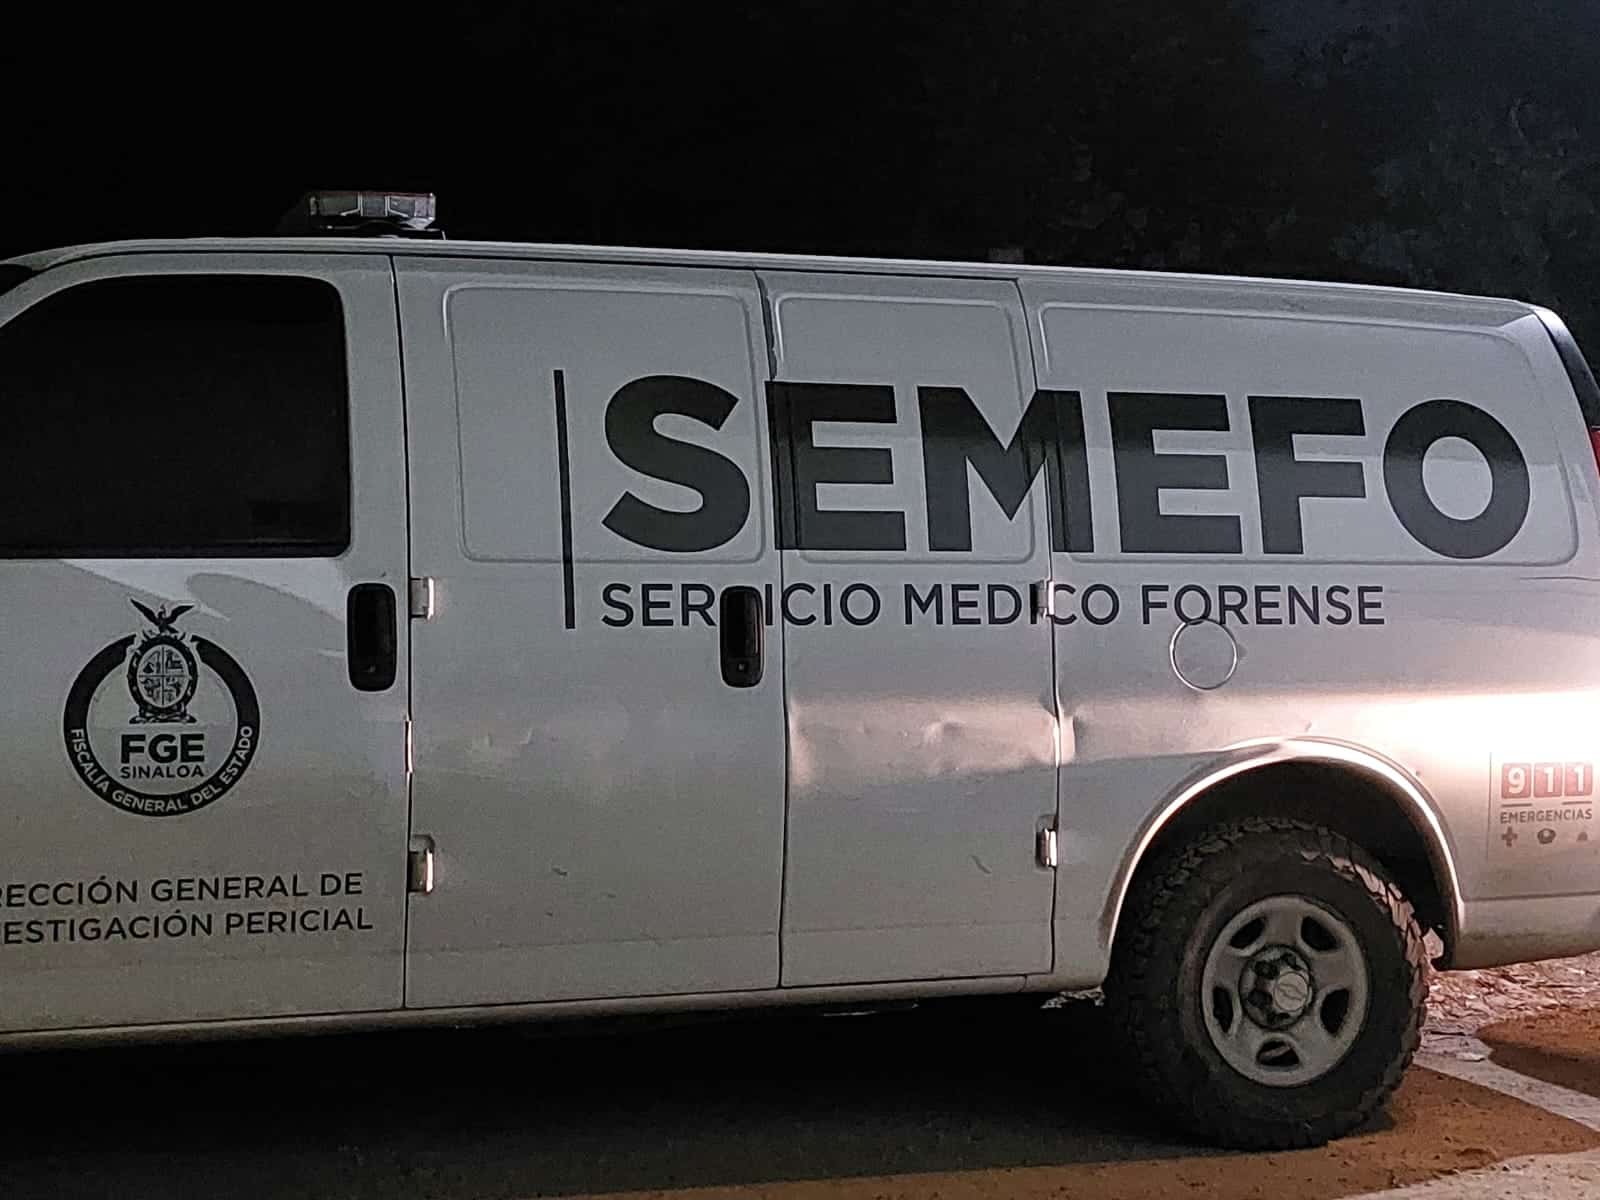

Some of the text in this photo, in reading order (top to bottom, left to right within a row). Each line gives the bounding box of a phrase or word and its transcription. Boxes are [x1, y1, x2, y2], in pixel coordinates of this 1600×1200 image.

[602, 373, 1530, 559] SEMEFO
[601, 583, 1385, 627] SERICIO MEDICO FORENSE
[121, 733, 205, 763] FGE
[112, 790, 187, 812] GENERAL
[191, 784, 222, 805] DEL
[222, 726, 253, 784] ESTADO
[120, 765, 205, 779] SINALOA
[1508, 766, 1586, 795] 911
[1500, 808, 1592, 823] EMERGENCIAS
[0, 872, 363, 908] ECCIÓN GENERAL DE
[225, 908, 373, 935] PERICIAL
